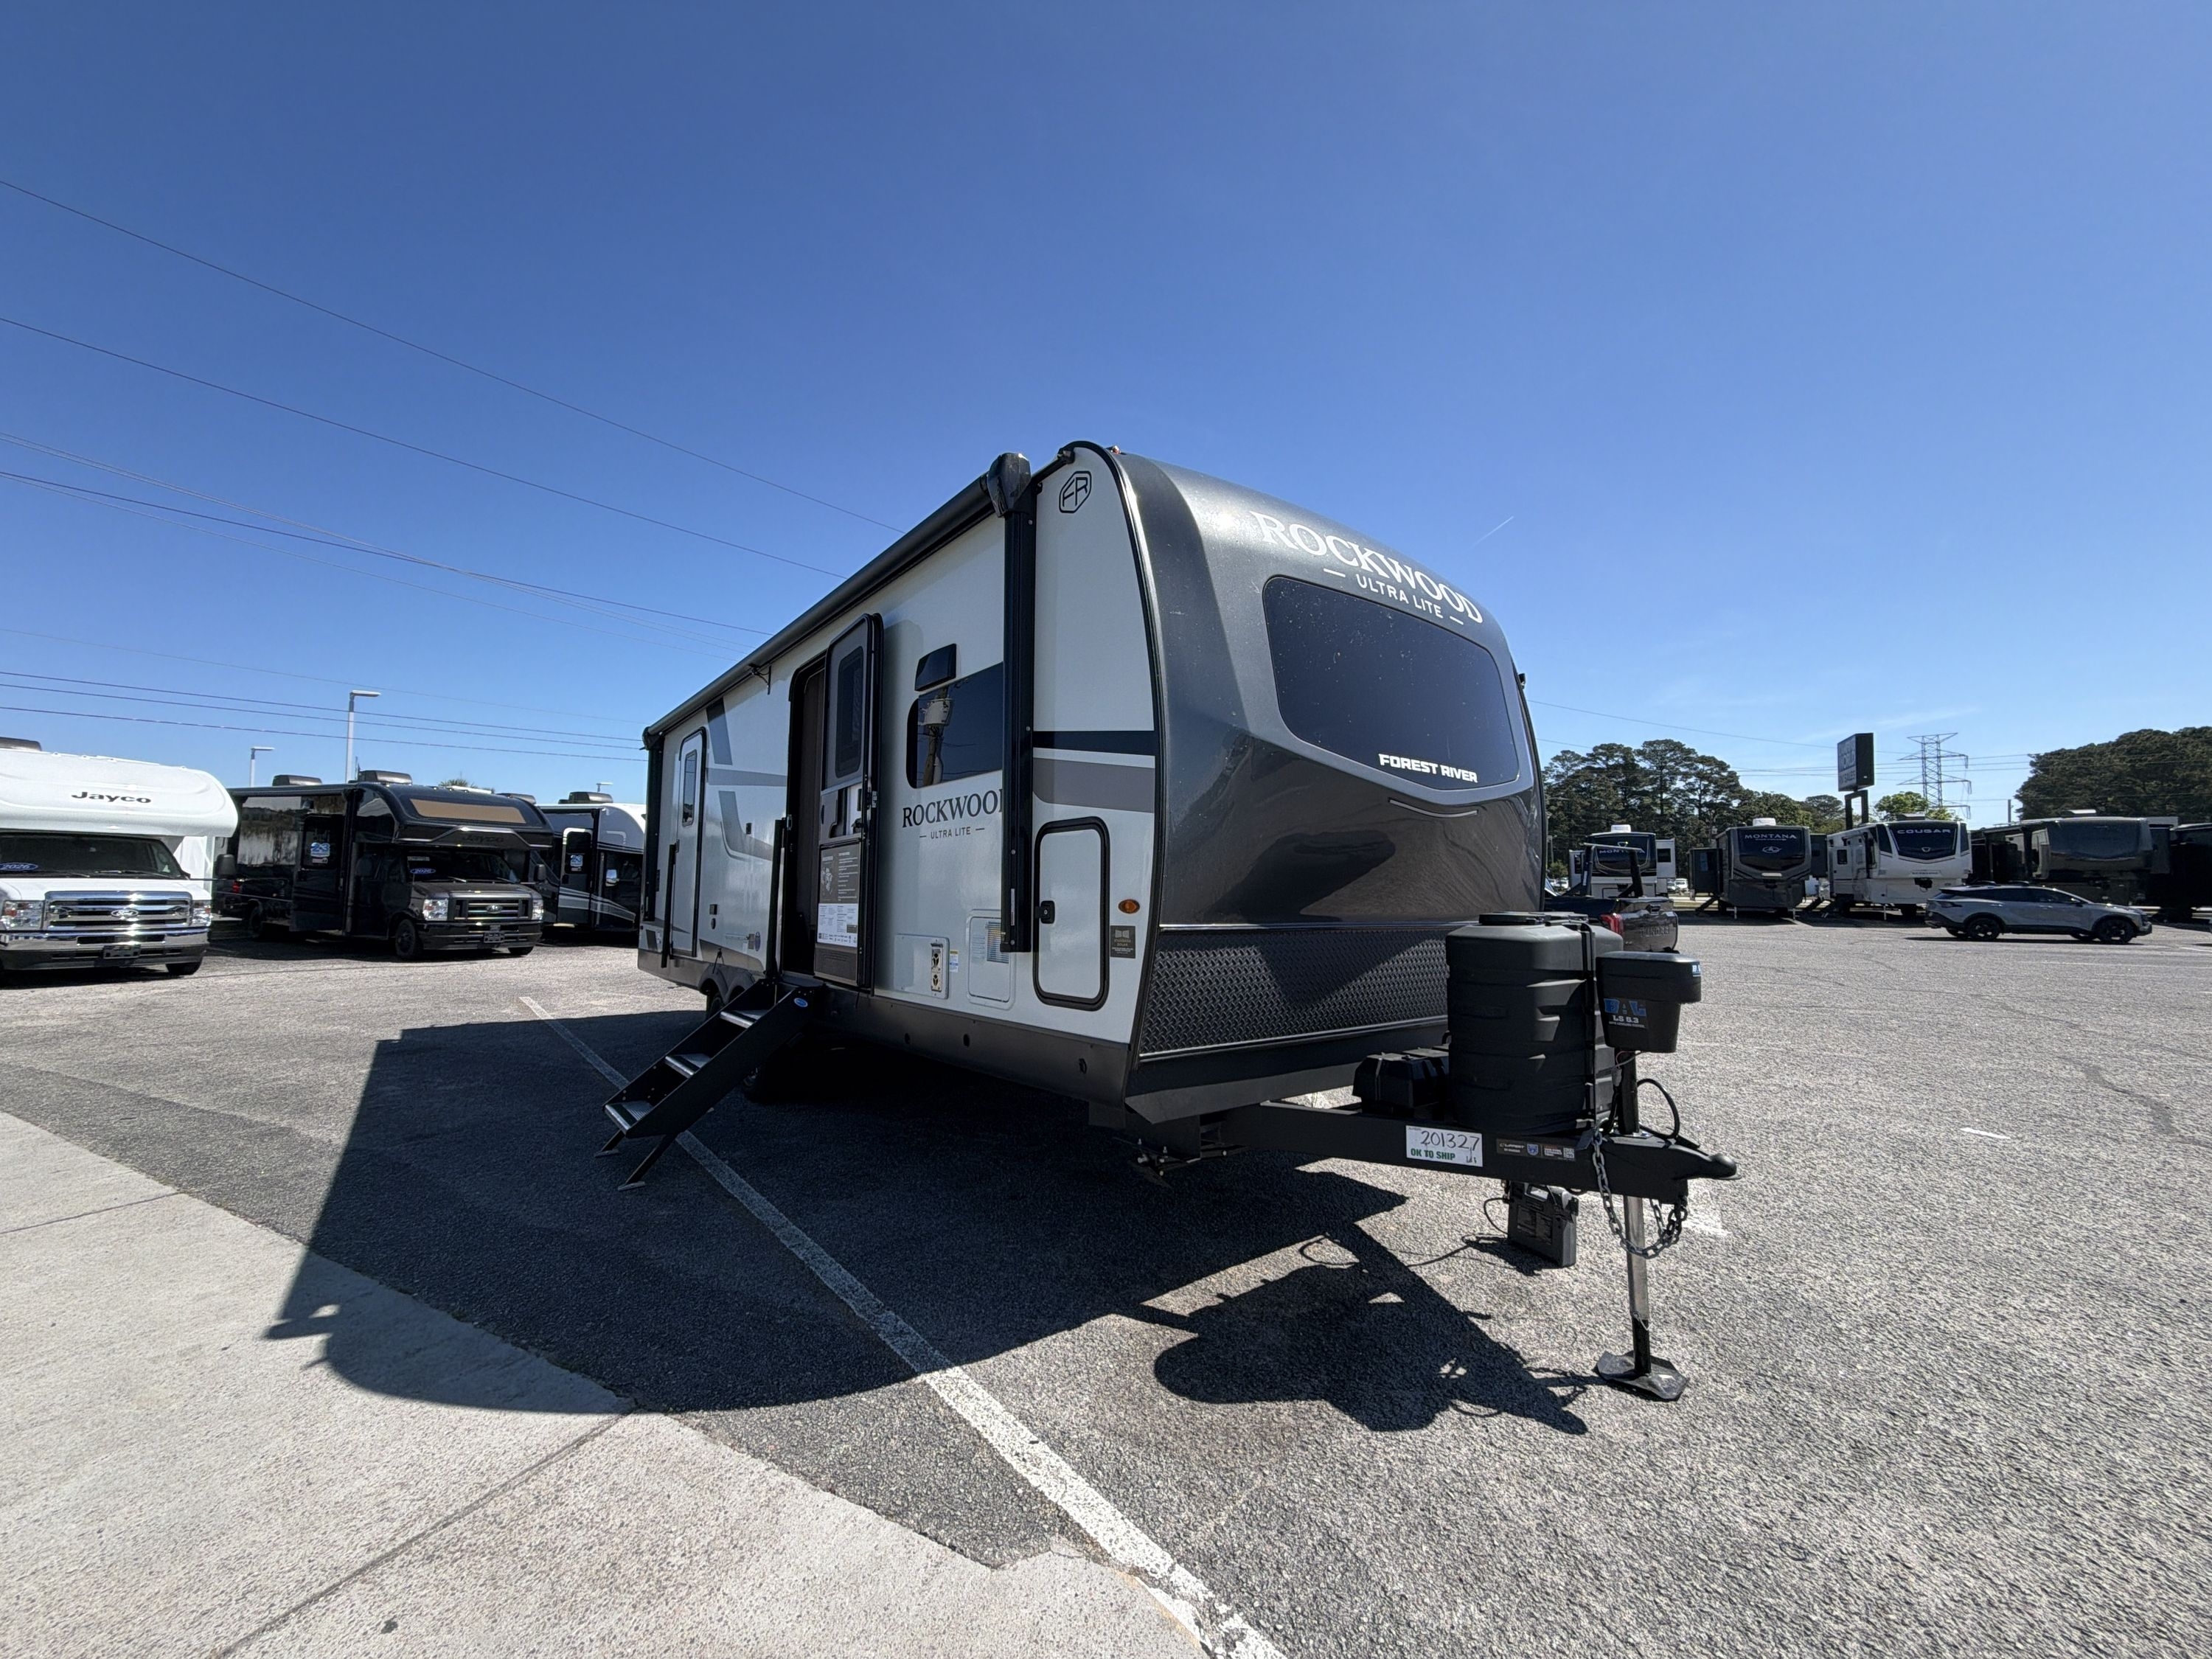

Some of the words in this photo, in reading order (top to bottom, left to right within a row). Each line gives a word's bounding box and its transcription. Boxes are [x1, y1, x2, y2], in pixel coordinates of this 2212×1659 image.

[1249, 510, 1483, 624] ROCKWOOD
[1355, 574, 1409, 604] ULTRA
[1413, 597, 1444, 619] LITE
[1378, 754, 1439, 774] FOREST
[1440, 764, 1478, 783] RIVER
[71, 791, 152, 804] Jayco
[931, 830, 953, 839] ULTRA
[955, 827, 971, 836] LITE
[1420, 1130, 1480, 1151] 201327
[1411, 1148, 1422, 1157] OK
[1424, 1150, 1434, 1158] TO
[1436, 1151, 1455, 1161] SHIP
